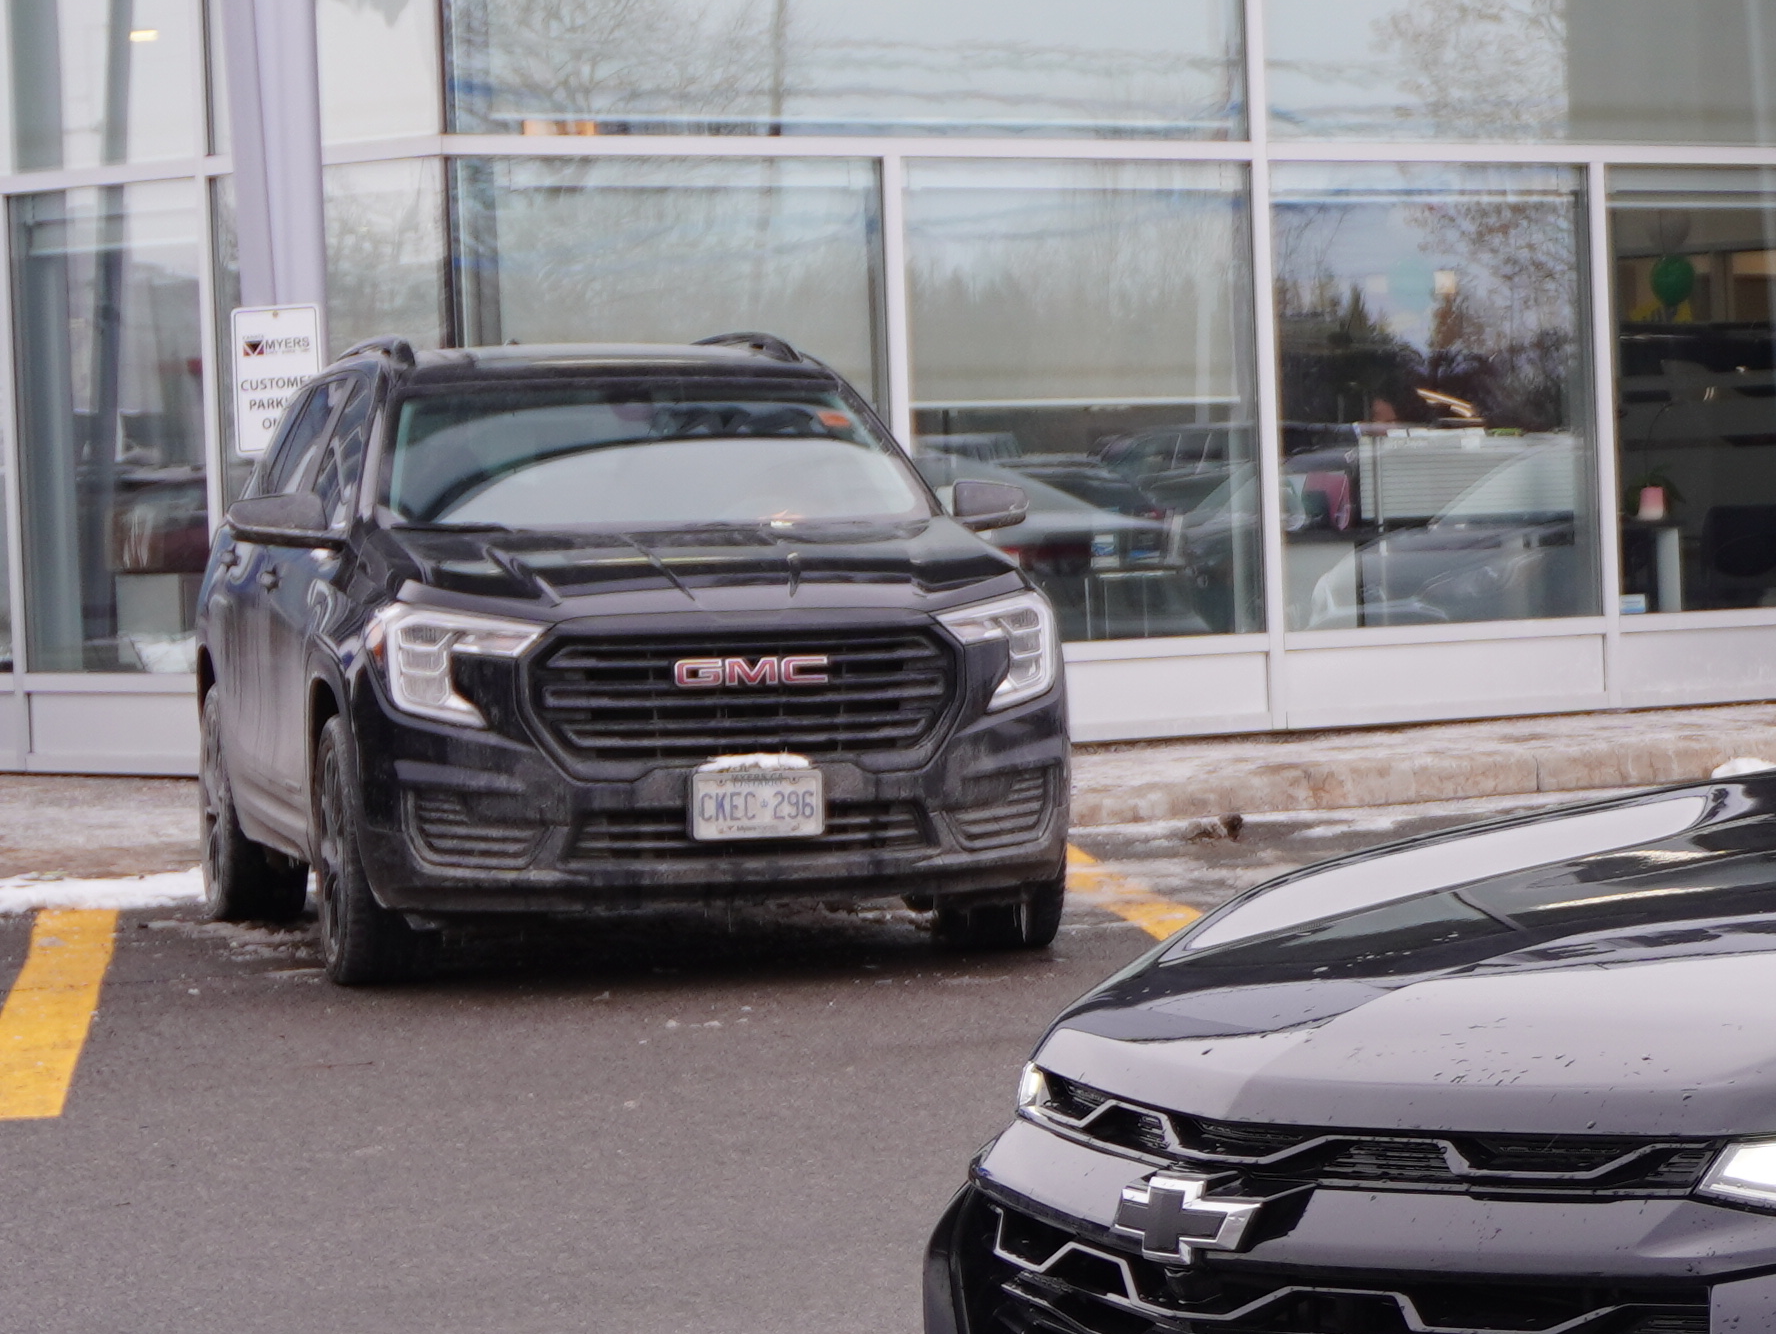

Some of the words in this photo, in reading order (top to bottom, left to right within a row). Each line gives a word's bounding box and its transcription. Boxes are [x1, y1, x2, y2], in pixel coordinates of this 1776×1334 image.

[265, 337, 310, 351] MYERS
[240, 375, 312, 391] CUSTOME
[674, 655, 829, 687] GMC
[700, 790, 757, 822] CKEC
[772, 789, 815, 820] 296
